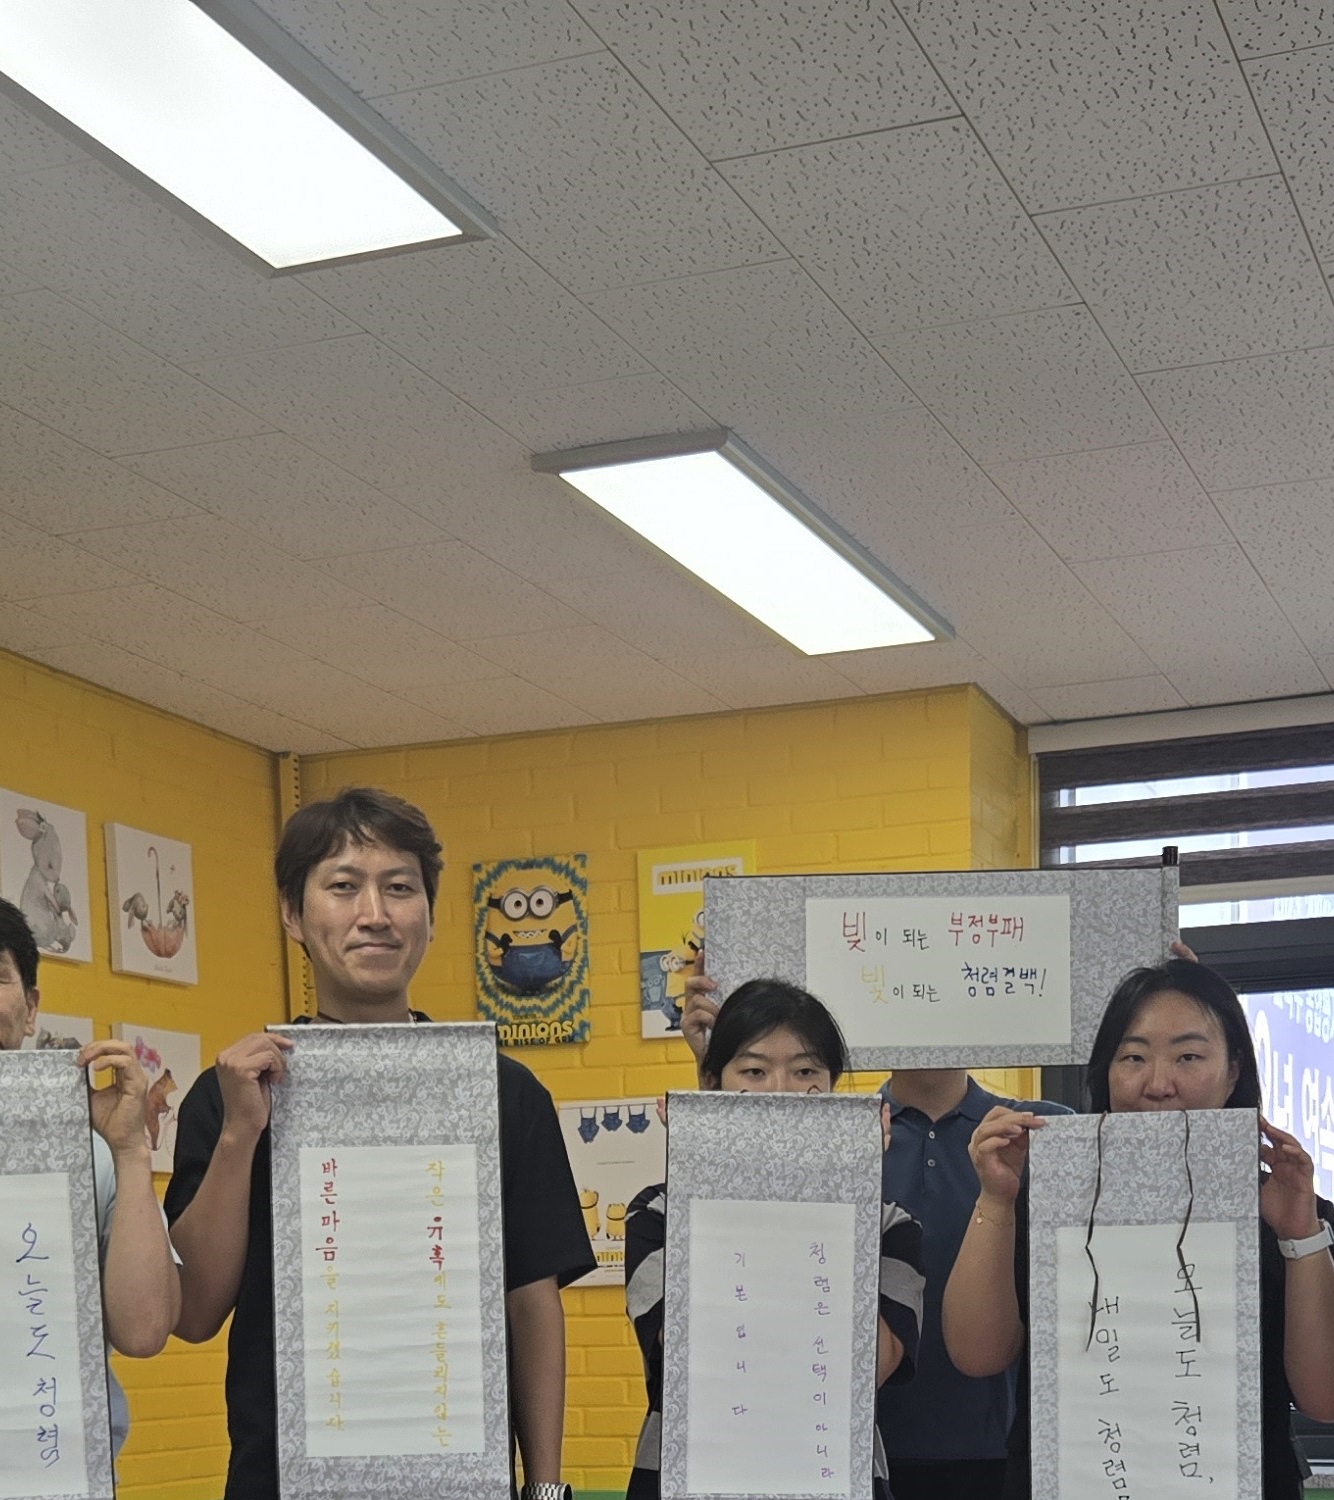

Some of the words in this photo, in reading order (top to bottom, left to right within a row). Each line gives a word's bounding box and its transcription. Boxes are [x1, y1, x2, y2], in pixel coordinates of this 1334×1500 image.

[902, 928, 930, 951] 되는
[947, 911, 1025, 948] 부정부패
[912, 983, 942, 1003] 되는
[960, 961, 1048, 998] 청렴결백!
[319, 1157, 340, 1206] 바른
[424, 1159, 446, 1208] 작은
[315, 1209, 341, 1291] 마음을
[426, 1215, 452, 1310] 유혹에도
[808, 1241, 832, 1318] 청렴은
[15, 1222, 57, 1360] 오늘도
[1170, 1263, 1205, 1379] 오늘도
[811, 1335, 830, 1406] 선택이
[1087, 1294, 1122, 1396] 내일도
[32, 1376, 62, 1470] 청렴
[815, 1423, 835, 1481] 아니라
